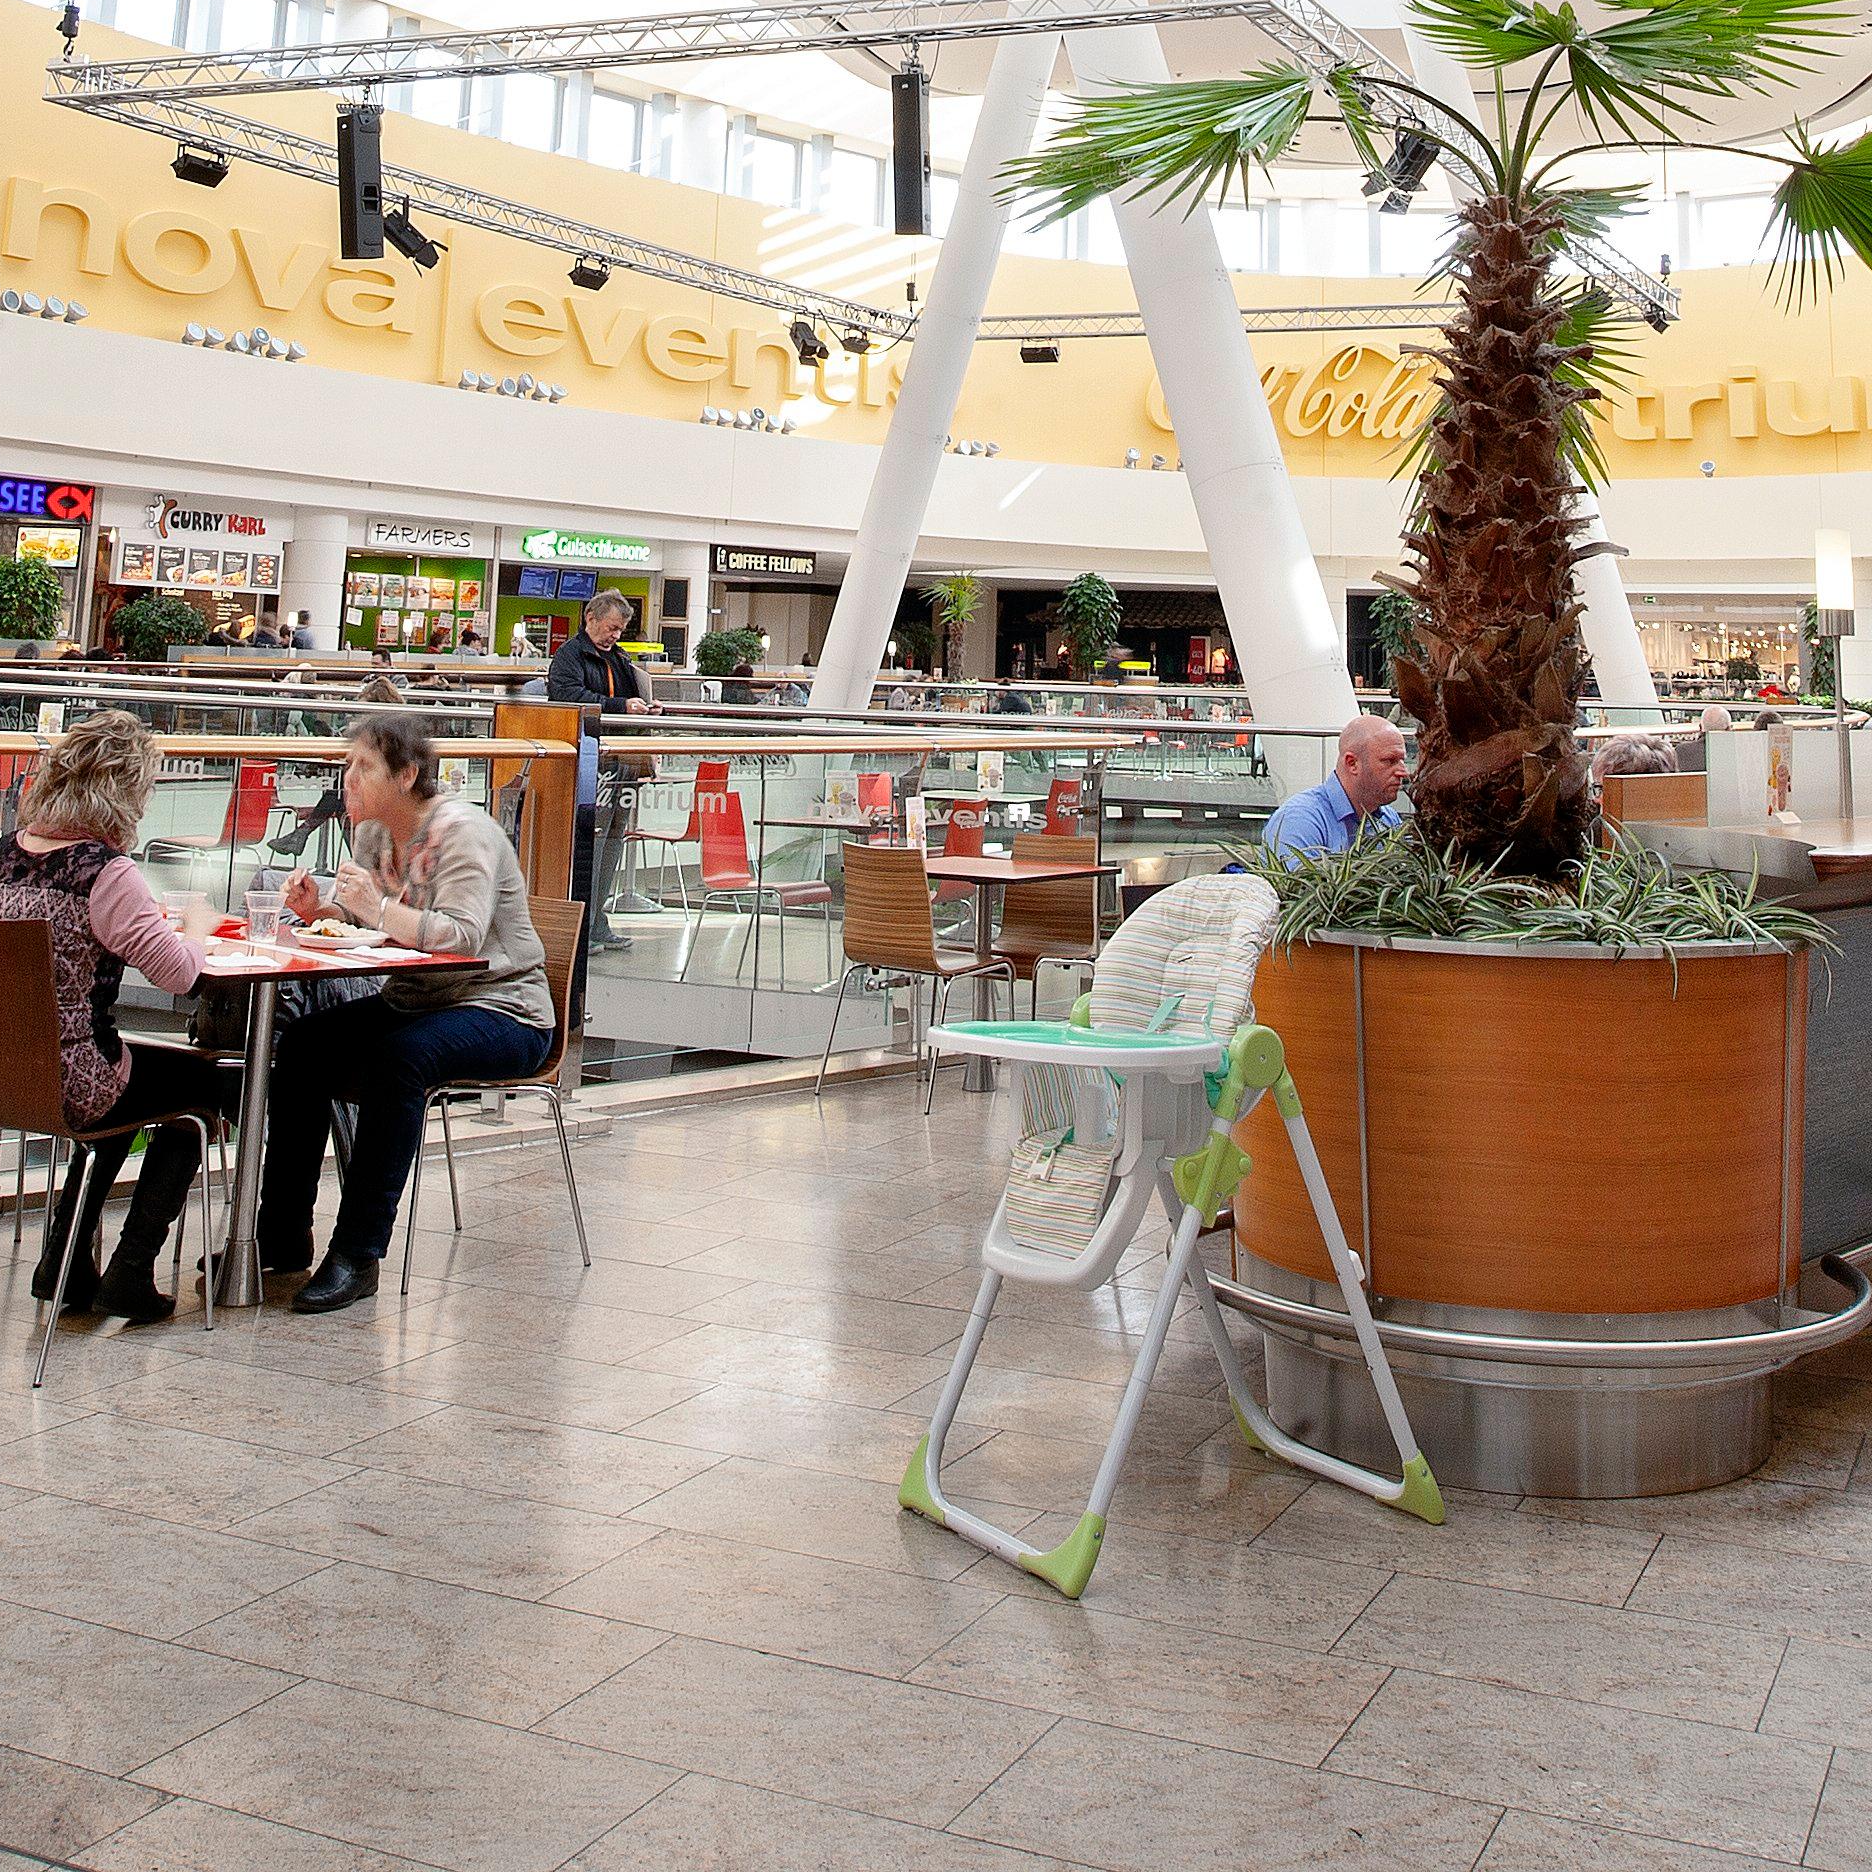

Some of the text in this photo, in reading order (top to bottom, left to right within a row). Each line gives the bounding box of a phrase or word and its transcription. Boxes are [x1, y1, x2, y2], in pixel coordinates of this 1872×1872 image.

[171, 509, 224, 533] CURRY
[374, 522, 471, 549] FARMERS
[557, 536, 651, 562] Gulaschkanone
[728, 552, 814, 575] COFFEE FELLOWS
[618, 781, 728, 814] atrium
[925, 804, 1049, 830] ventis
